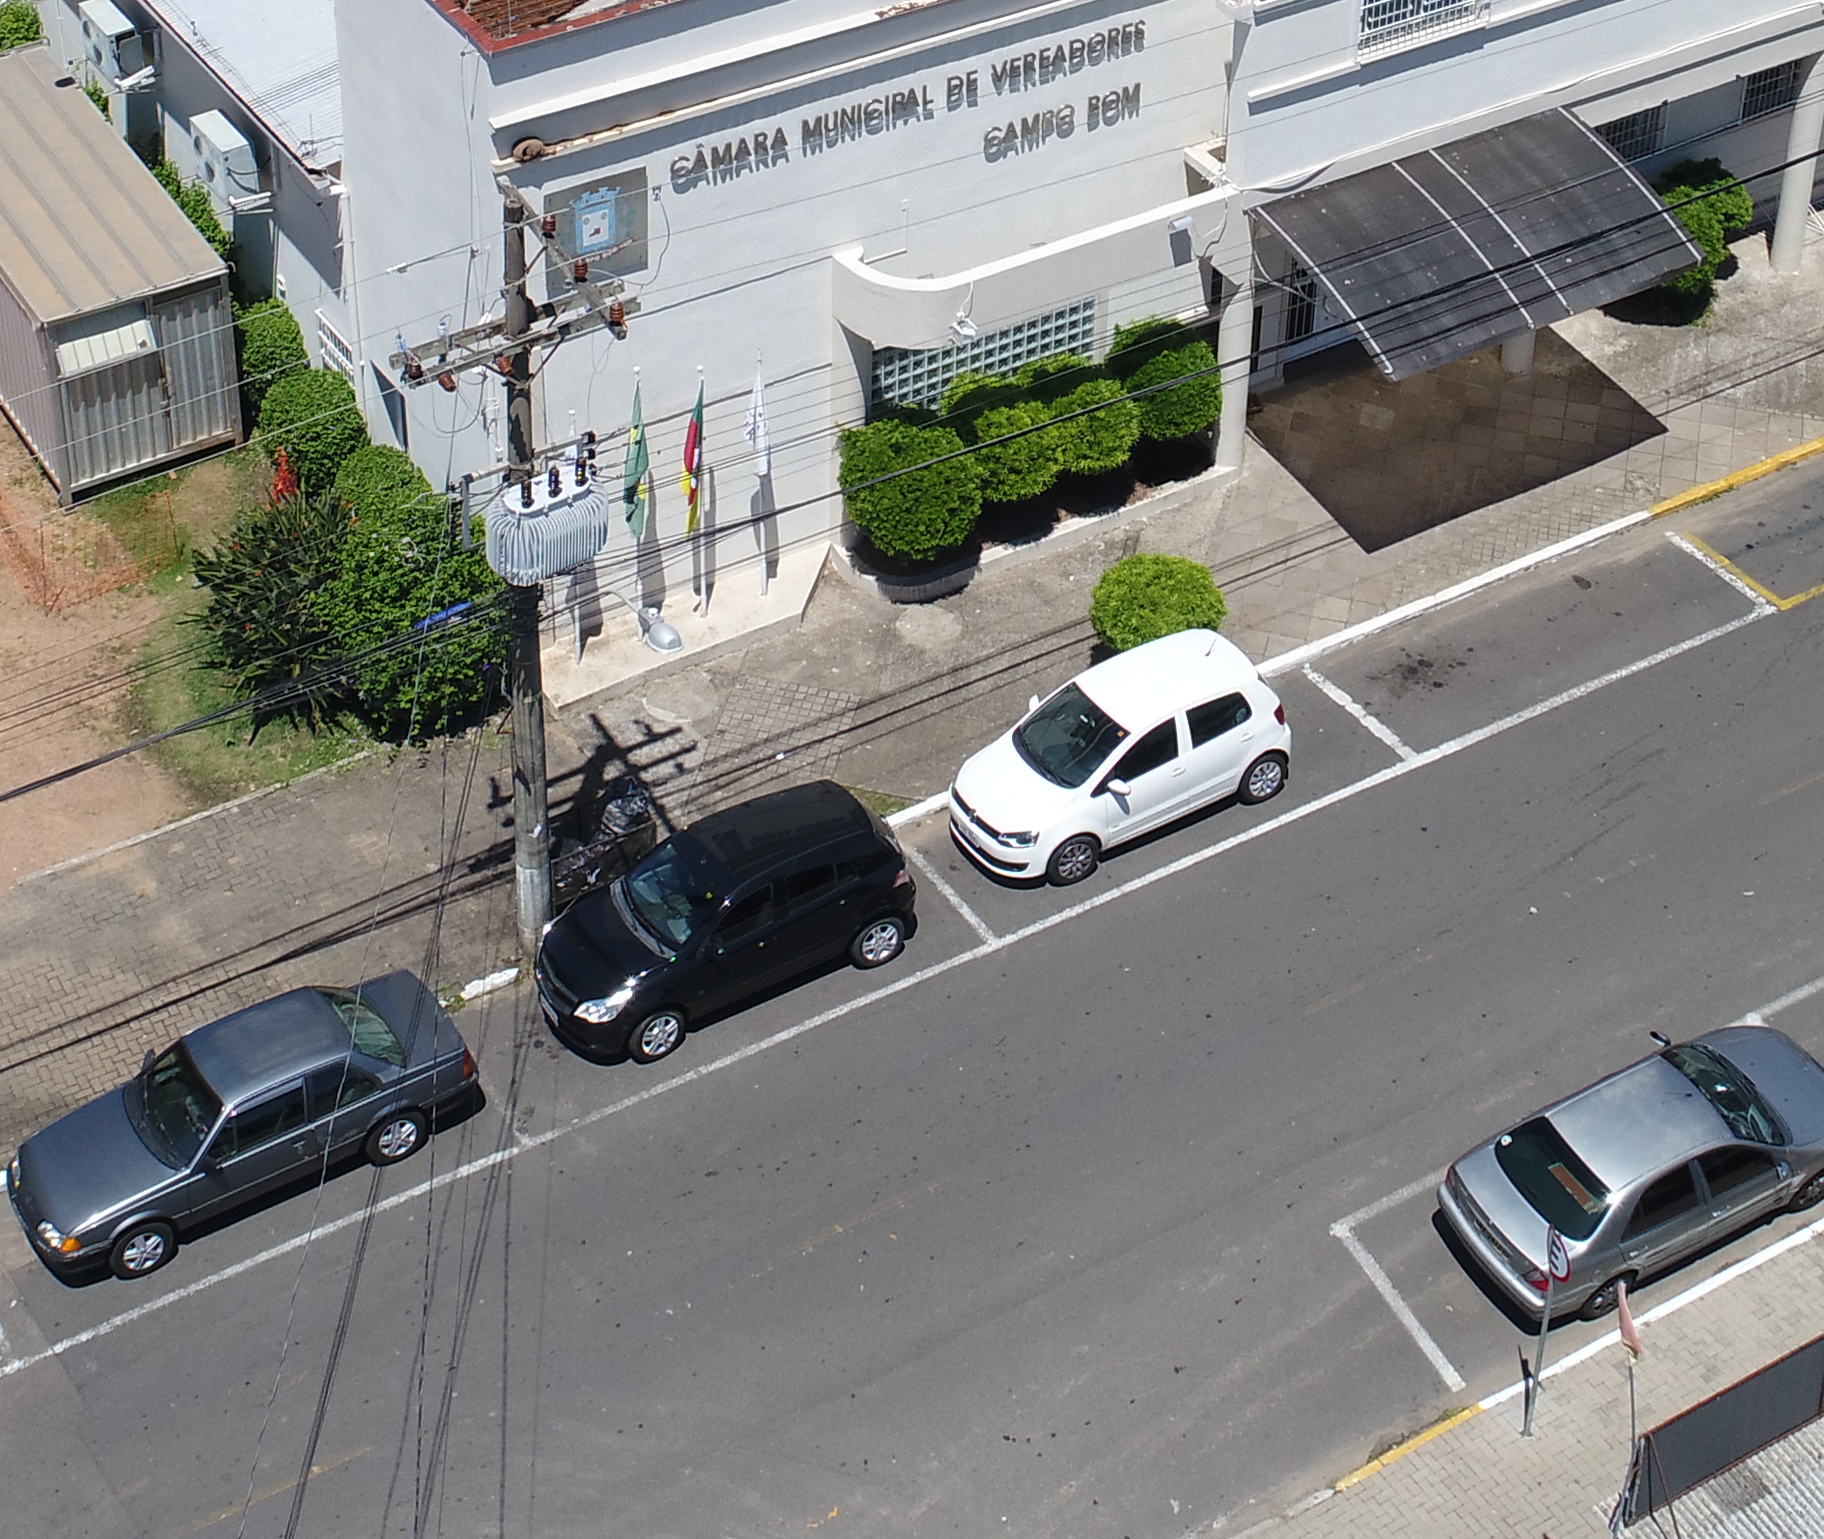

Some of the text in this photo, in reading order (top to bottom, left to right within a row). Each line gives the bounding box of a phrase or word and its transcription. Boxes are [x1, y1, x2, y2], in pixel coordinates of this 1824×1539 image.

[670, 19, 1146, 181] CÂMARA MUNICIPAL DE VEREADORES
[984, 82, 1142, 151] CAMPO BOM
